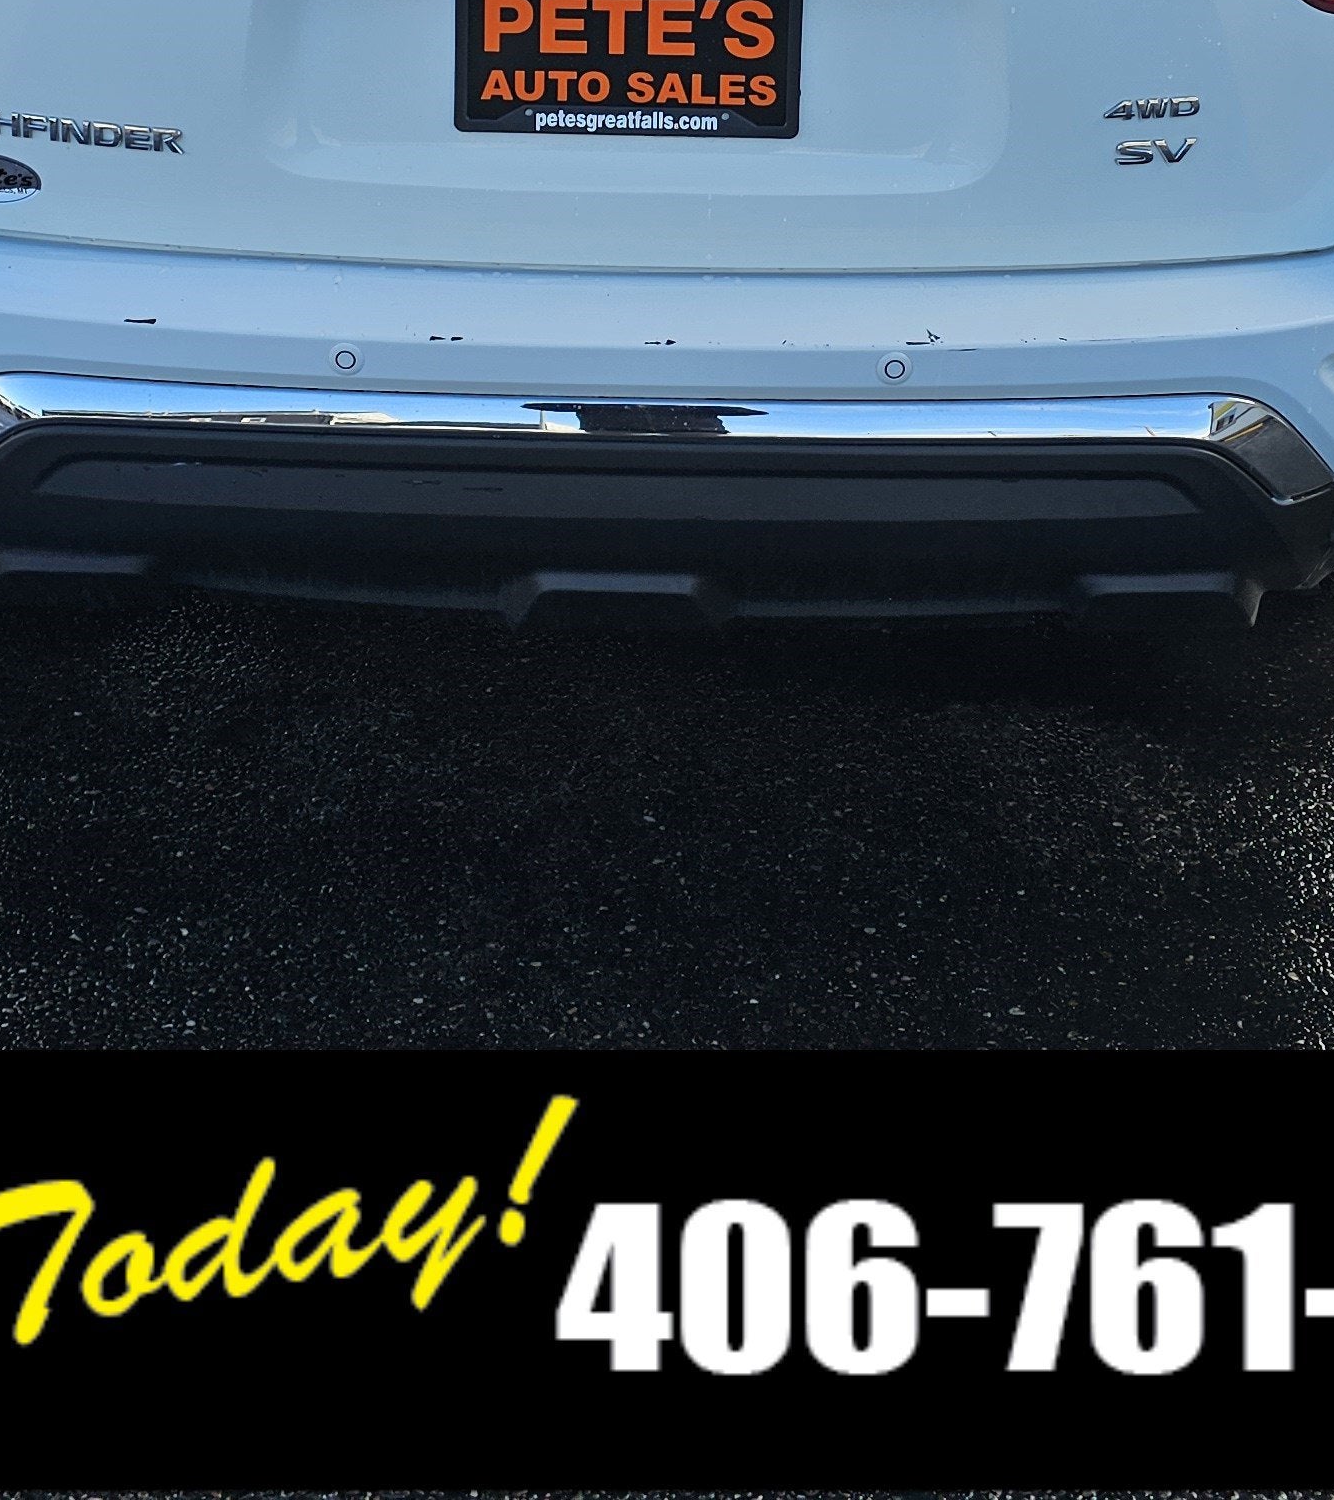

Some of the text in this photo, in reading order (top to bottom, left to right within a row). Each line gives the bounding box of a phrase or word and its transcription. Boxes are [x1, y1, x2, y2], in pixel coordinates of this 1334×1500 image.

[480, 69, 777, 106] AUTO SALES
[535, 108, 718, 132] petesgreatfalls.com
[1103, 95, 1201, 121] 4WD
[1114, 136, 1198, 166] SV
